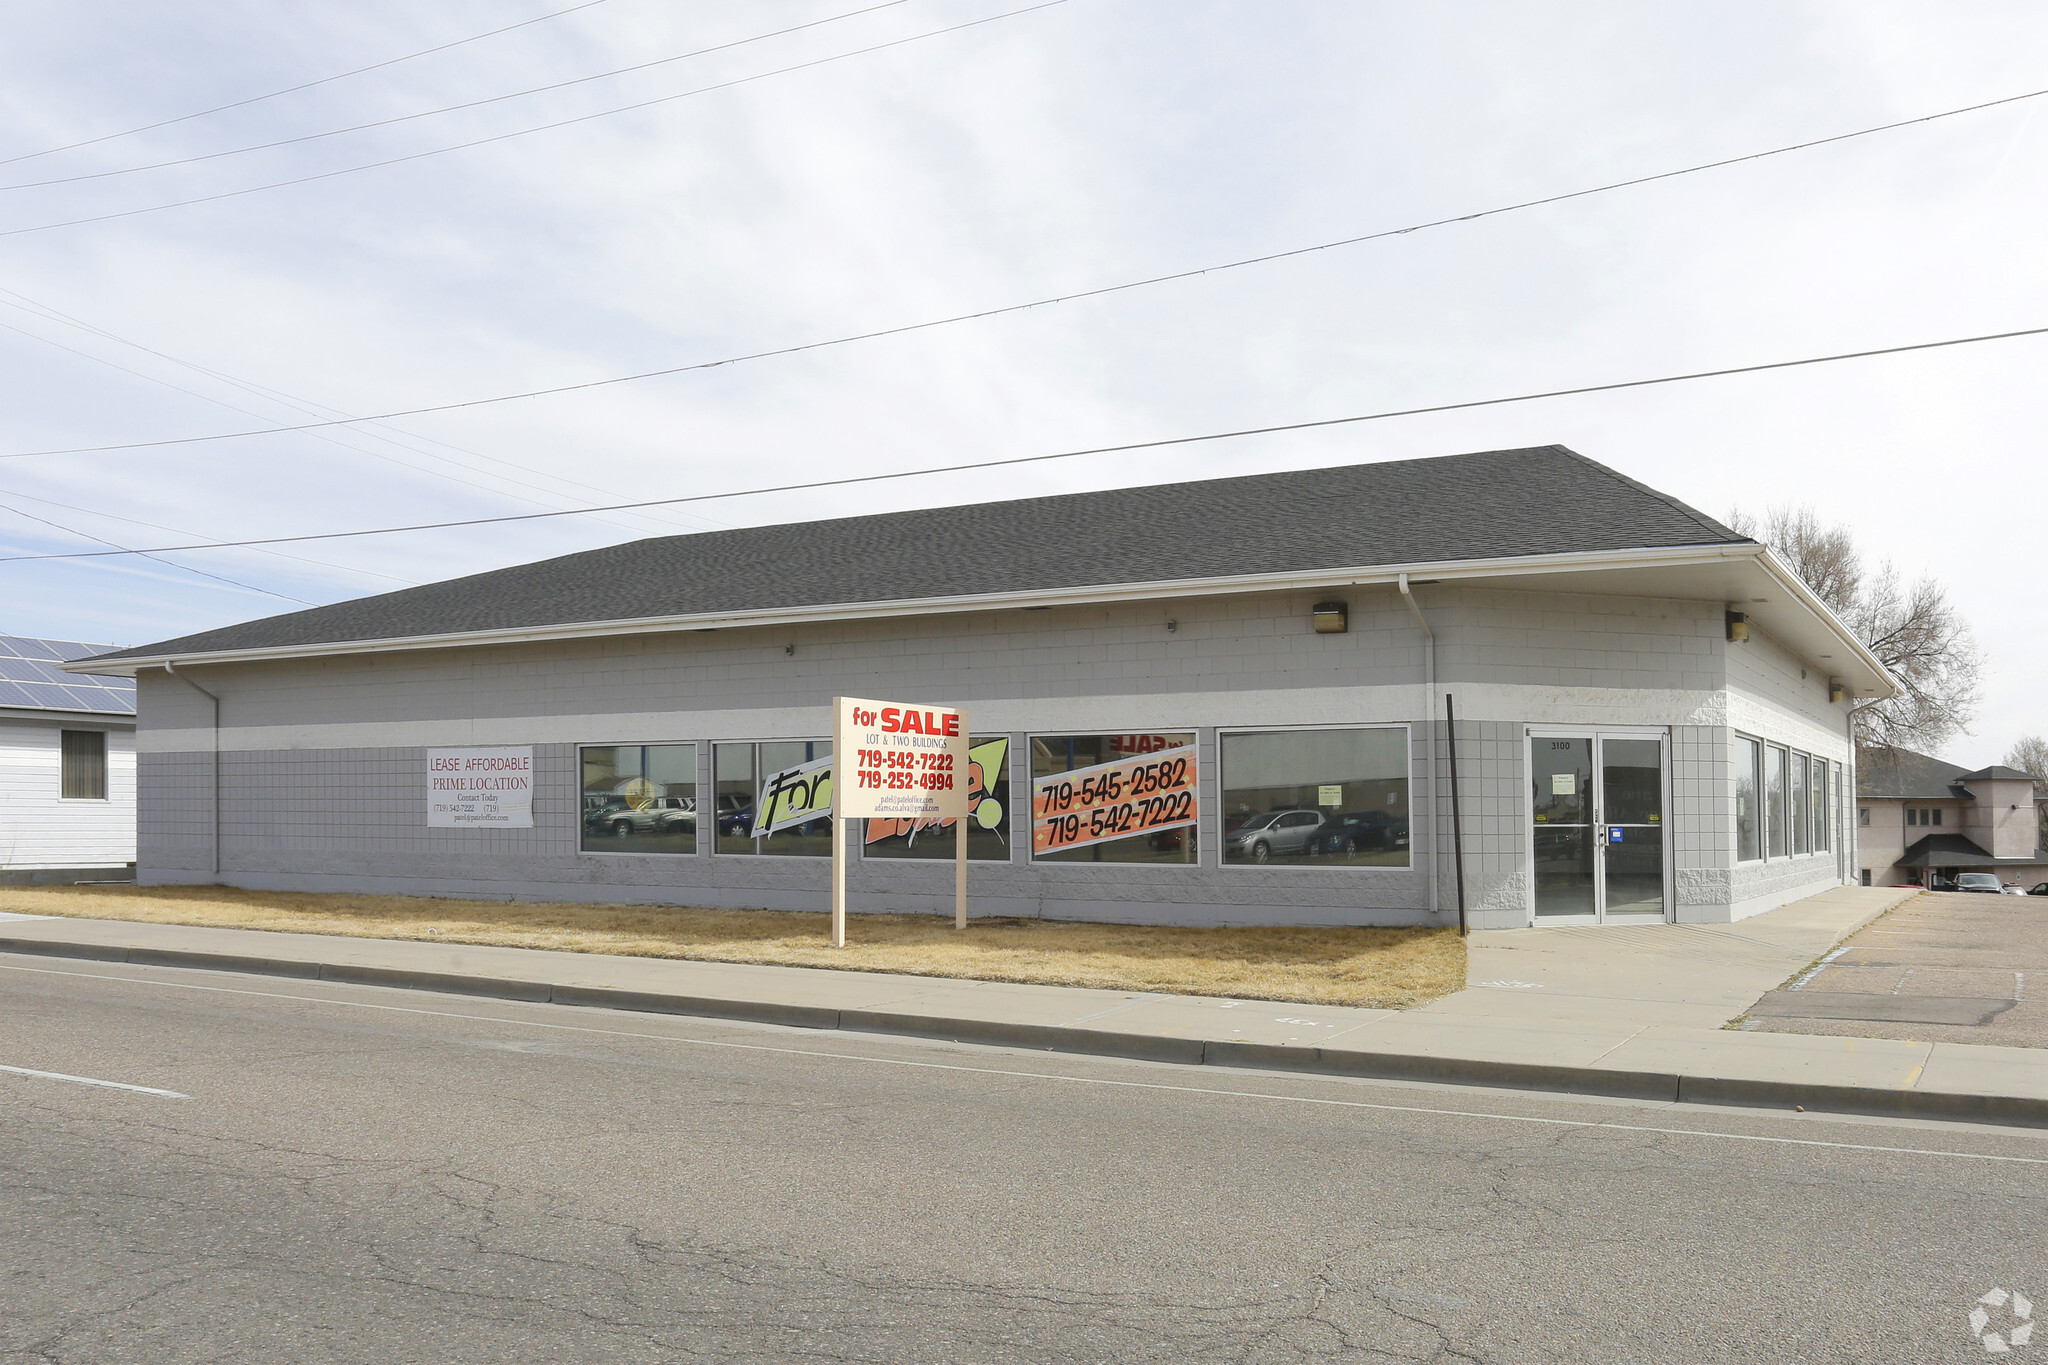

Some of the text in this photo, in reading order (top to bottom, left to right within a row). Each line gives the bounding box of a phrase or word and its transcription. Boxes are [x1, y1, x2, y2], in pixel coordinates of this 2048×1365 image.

[853, 707, 959, 737] for SALE
[866, 734, 947, 749] LOT & TWO BUILDINGS
[1551, 741, 1570, 750] 3100
[430, 756, 529, 771] LEASE AFFORDABLE
[857, 749, 954, 771] 719-542-7222
[432, 776, 528, 790] PRIME LOCATION
[857, 770, 954, 790] 719-252-4994
[1042, 757, 1187, 813] 719-545-2582
[457, 793, 499, 804] Contact Today
[765, 770, 831, 830] For
[433, 804, 499, 813] (719) 542-7222 (719)
[1047, 791, 1192, 846] 719-542-7222
